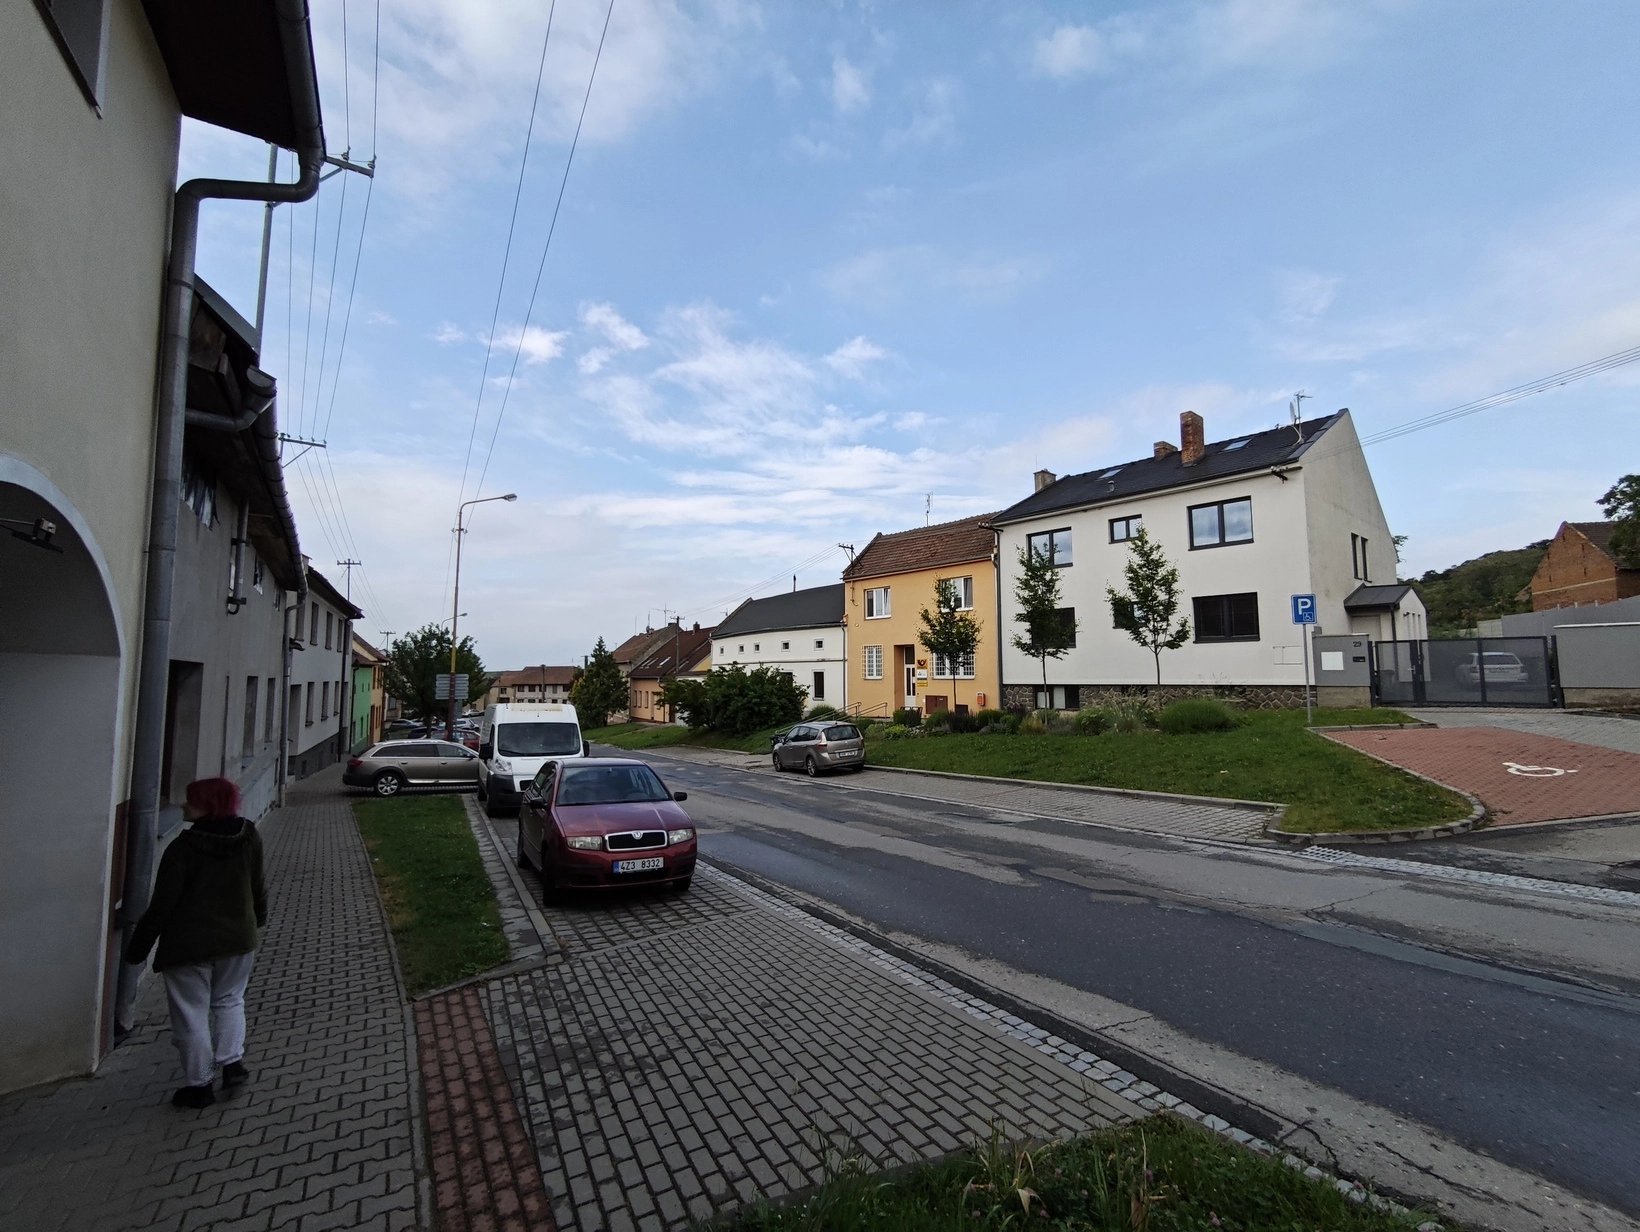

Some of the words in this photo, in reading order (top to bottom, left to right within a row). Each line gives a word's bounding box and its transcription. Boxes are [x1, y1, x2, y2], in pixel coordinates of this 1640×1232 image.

[1298, 598, 1311, 615] P
[621, 861, 636, 870] 4Z3
[641, 859, 660, 868] 8332
